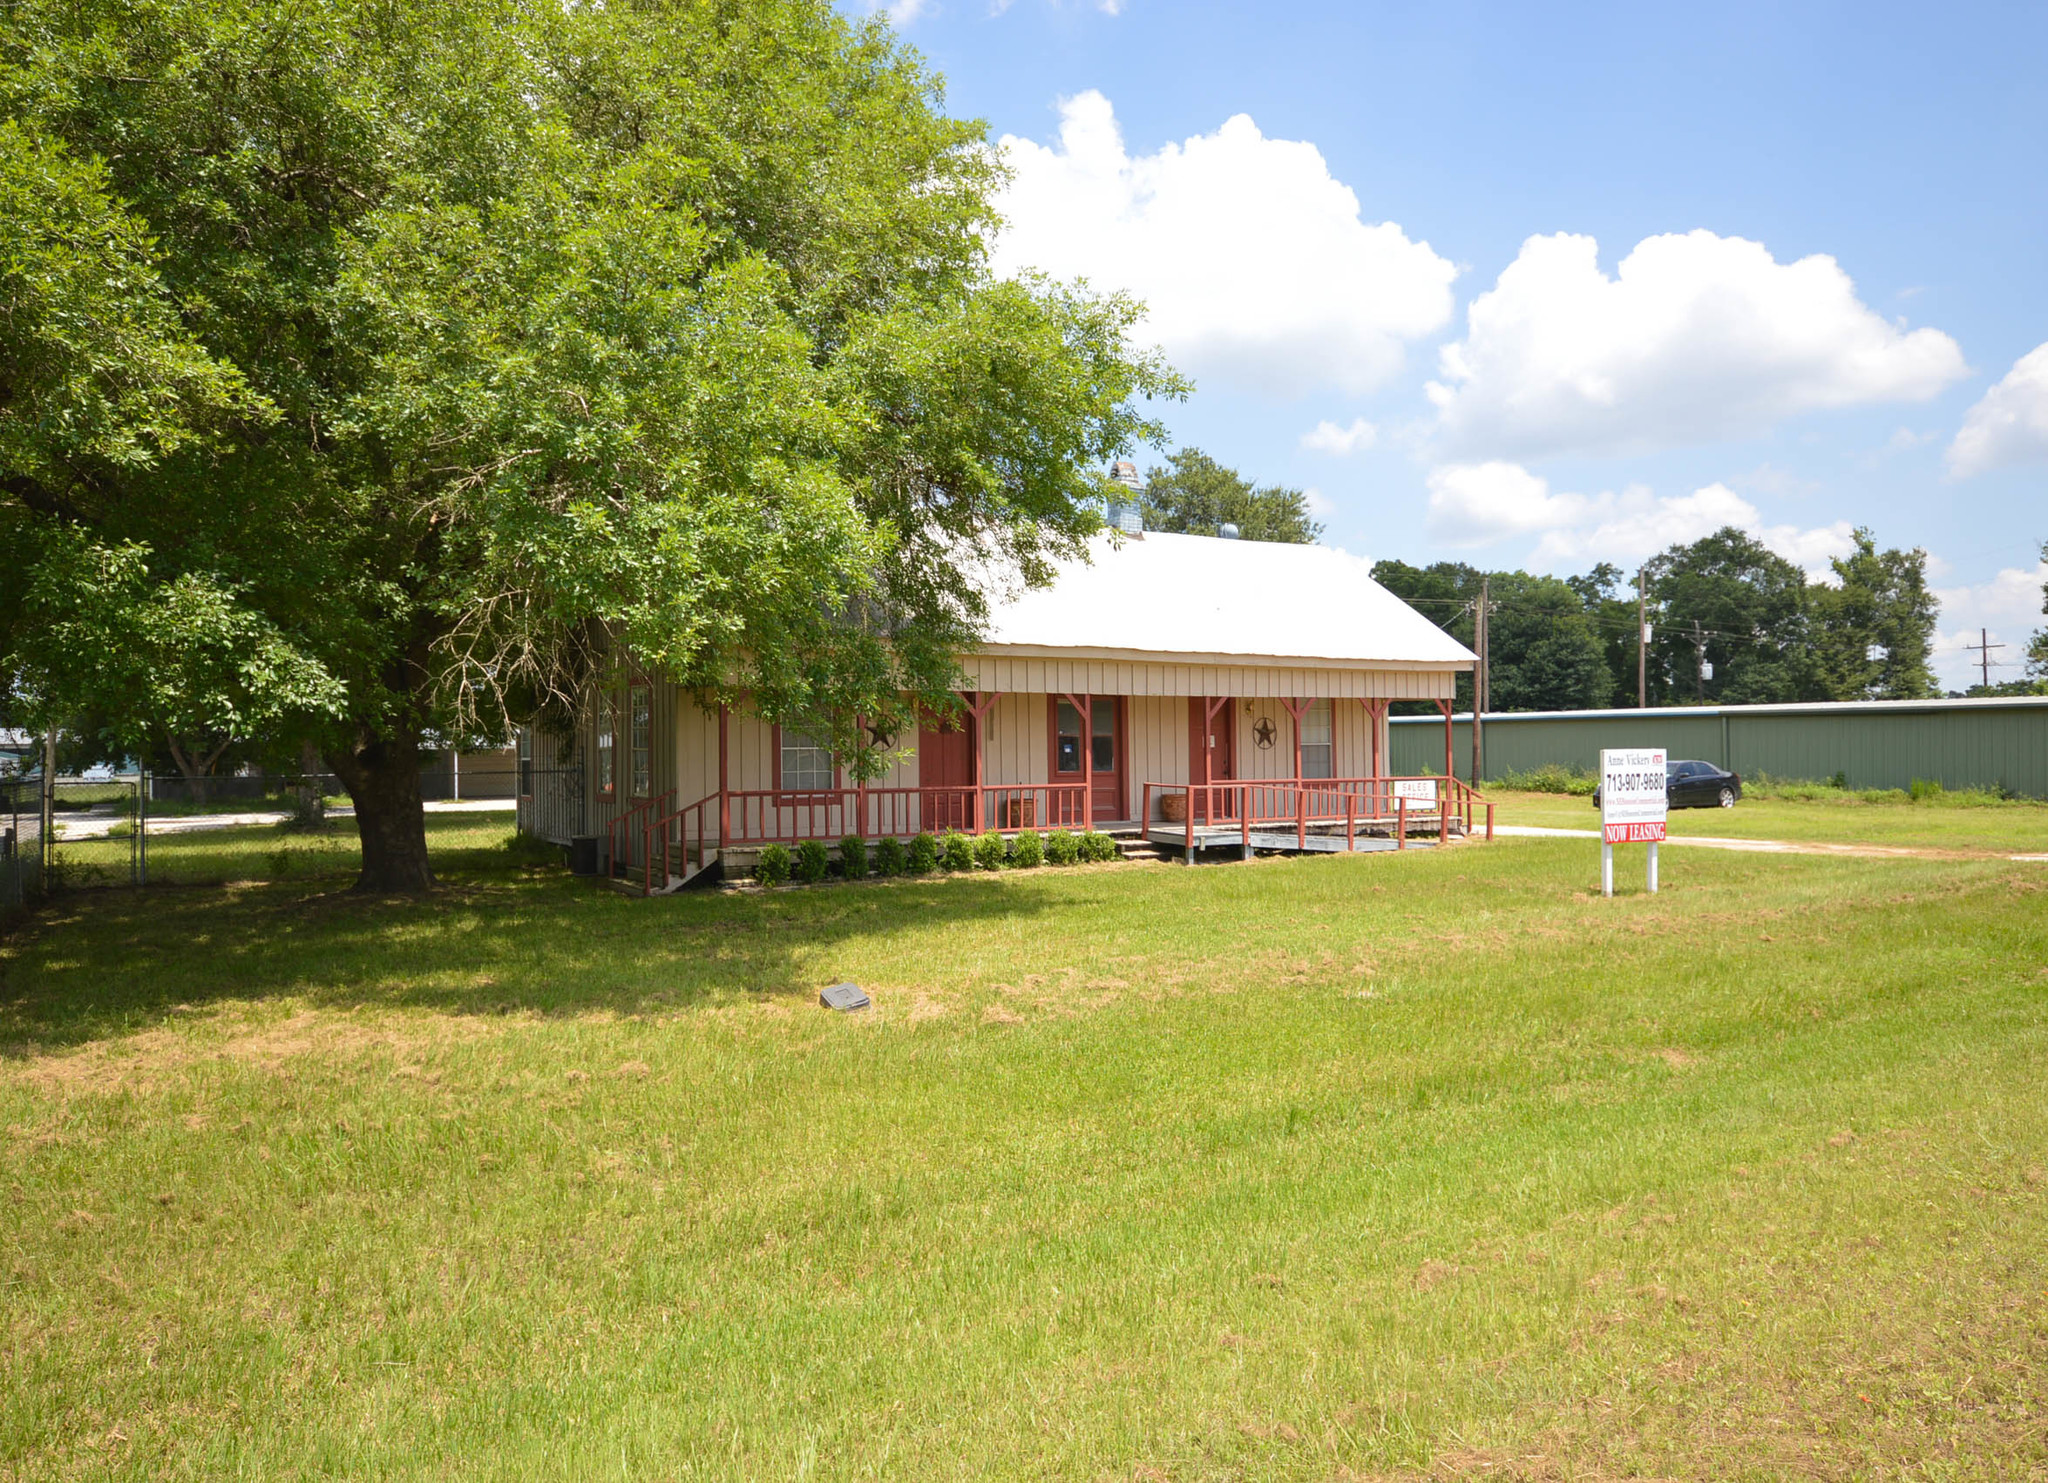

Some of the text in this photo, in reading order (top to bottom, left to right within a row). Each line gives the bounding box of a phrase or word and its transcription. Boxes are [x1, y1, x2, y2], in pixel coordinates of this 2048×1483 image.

[1608, 755, 1624, 766] Anne
[1402, 782, 1427, 792] SALES
[1606, 773, 1664, 792] 713-907-9680
[1605, 823, 1665, 842] NOW LEASING
